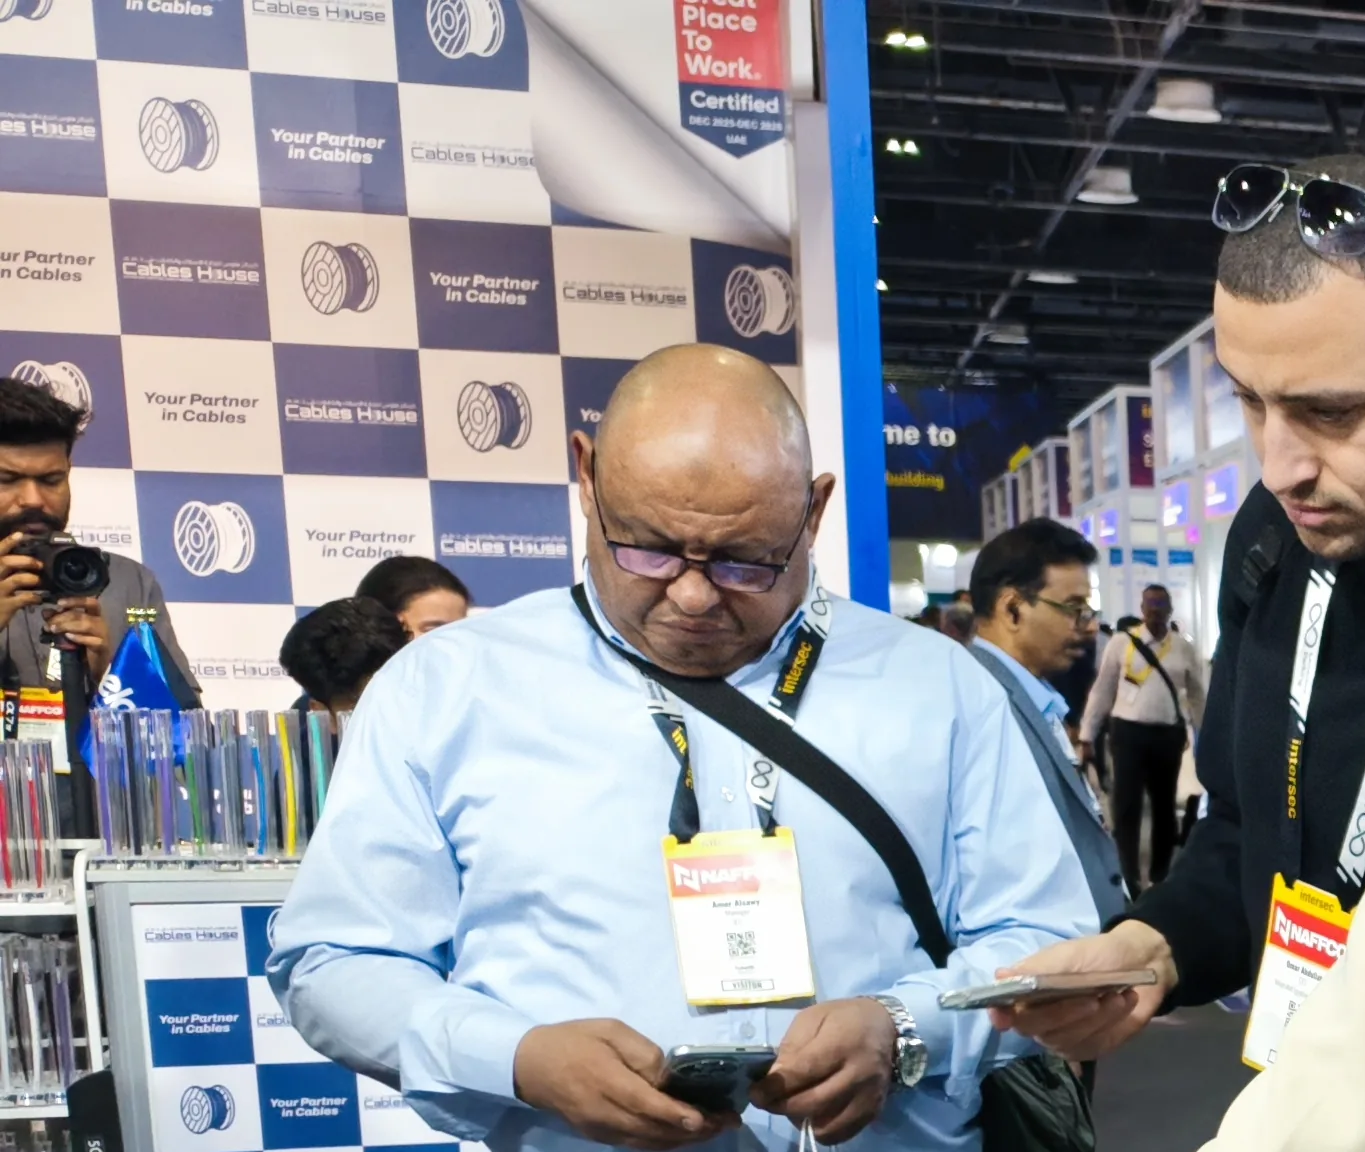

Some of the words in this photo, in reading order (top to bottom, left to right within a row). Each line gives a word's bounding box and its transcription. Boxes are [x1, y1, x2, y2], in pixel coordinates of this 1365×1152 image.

[143, 0, 213, 16] Cables
[252, 0, 319, 18] Cables
[682, 4, 757, 32] Place
[681, 29, 713, 52] To
[690, 90, 779, 113] Certified
[271, 128, 313, 146] Your
[319, 132, 385, 150] Partner
[288, 145, 305, 160] in
[309, 147, 373, 165] Cables
[411, 146, 476, 163] Cables
[24, 250, 95, 266] Partner
[16, 266, 82, 282] Cables
[123, 262, 192, 279] Cables
[430, 272, 470, 288] Your
[473, 273, 539, 291] Partner
[446, 287, 462, 301] in
[466, 288, 526, 305] Cables
[562, 286, 626, 303] Cables
[144, 391, 185, 408] Your
[190, 393, 260, 409] Partner
[162, 407, 178, 421] in
[182, 408, 246, 424] Cables
[285, 404, 352, 421] Cables
[927, 422, 956, 448] to
[305, 529, 346, 543] Your
[350, 530, 416, 545] Partner
[322, 544, 337, 557] in
[342, 546, 404, 559] Cables
[440, 539, 506, 555] Cables
[779, 641, 812, 694] intersec
[1287, 738, 1302, 819] intersec
[1300, 888, 1335, 913] intersec
[145, 931, 191, 941] Cables
[1291, 926, 1348, 958] NAFFCO
[160, 1014, 188, 1024] Your
[191, 1013, 239, 1024] Partner
[172, 1025, 183, 1034] in
[186, 1024, 230, 1034] Cables
[270, 1098, 298, 1108] Your
[300, 1097, 348, 1108] Partner
[282, 1108, 293, 1117] in
[295, 1107, 339, 1118] Cables
